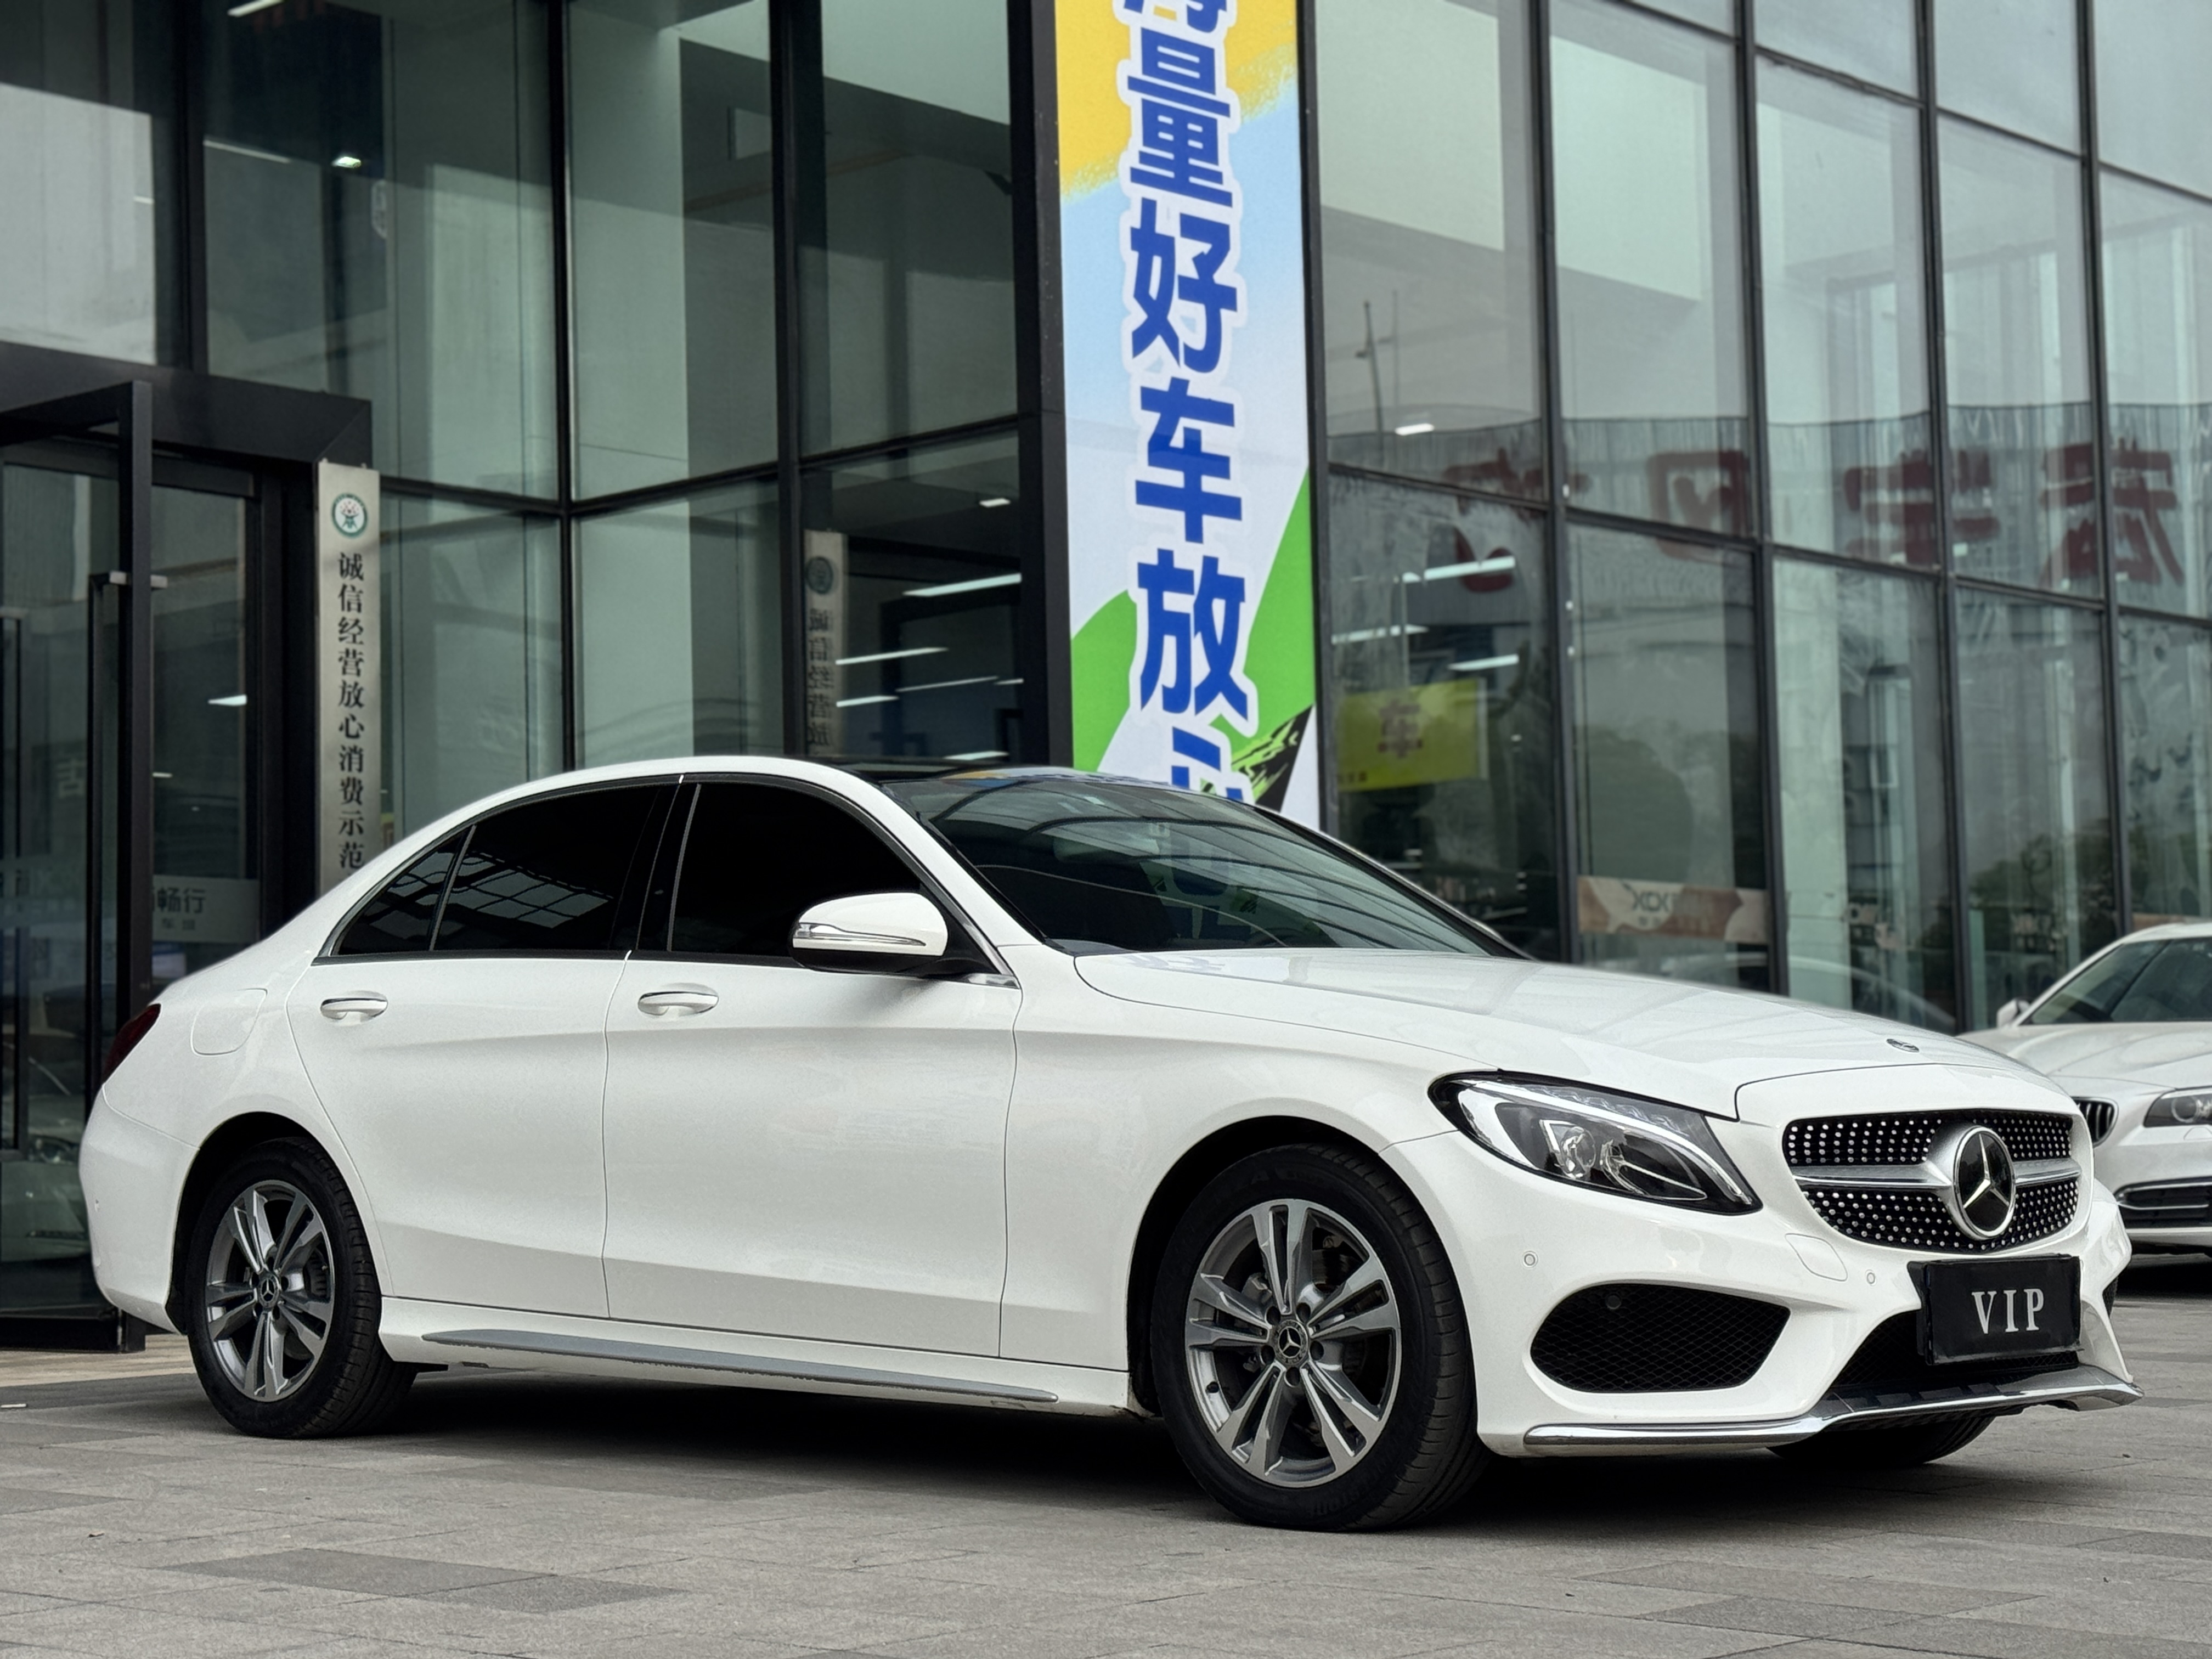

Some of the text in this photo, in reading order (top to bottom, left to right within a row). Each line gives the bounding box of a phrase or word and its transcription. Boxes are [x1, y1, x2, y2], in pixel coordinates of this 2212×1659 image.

[1124, 0, 1249, 800] 量好车放
[338, 552, 364, 876] 诚信经营放心消费示范
[153, 887, 206, 914] 畅行
[1972, 1289, 2044, 1334] VIP
